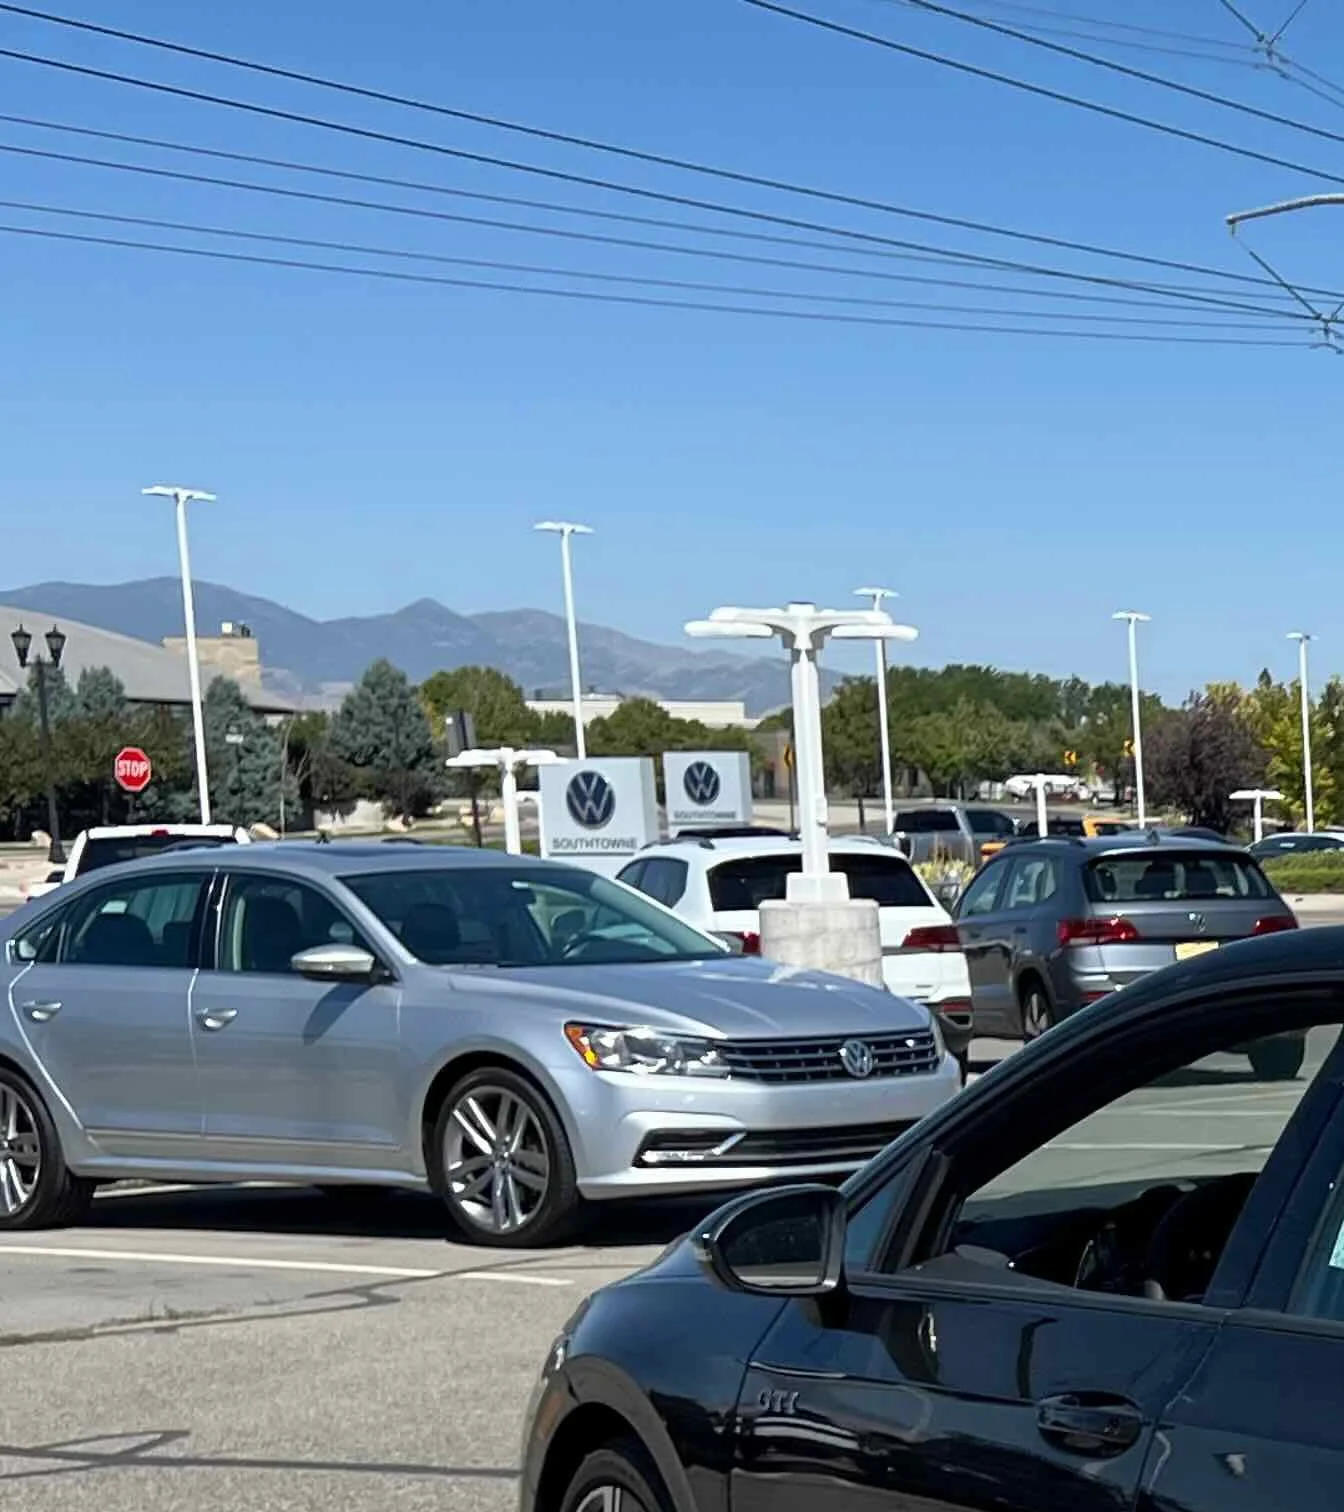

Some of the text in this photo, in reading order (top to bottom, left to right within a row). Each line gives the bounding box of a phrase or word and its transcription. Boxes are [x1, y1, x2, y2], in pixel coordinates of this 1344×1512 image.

[118, 759, 148, 777] STOP
[673, 810, 737, 820] SOUTHTOWNE
[552, 837, 638, 850] SOUTHTOWNE
[757, 1388, 800, 1414] GTI
